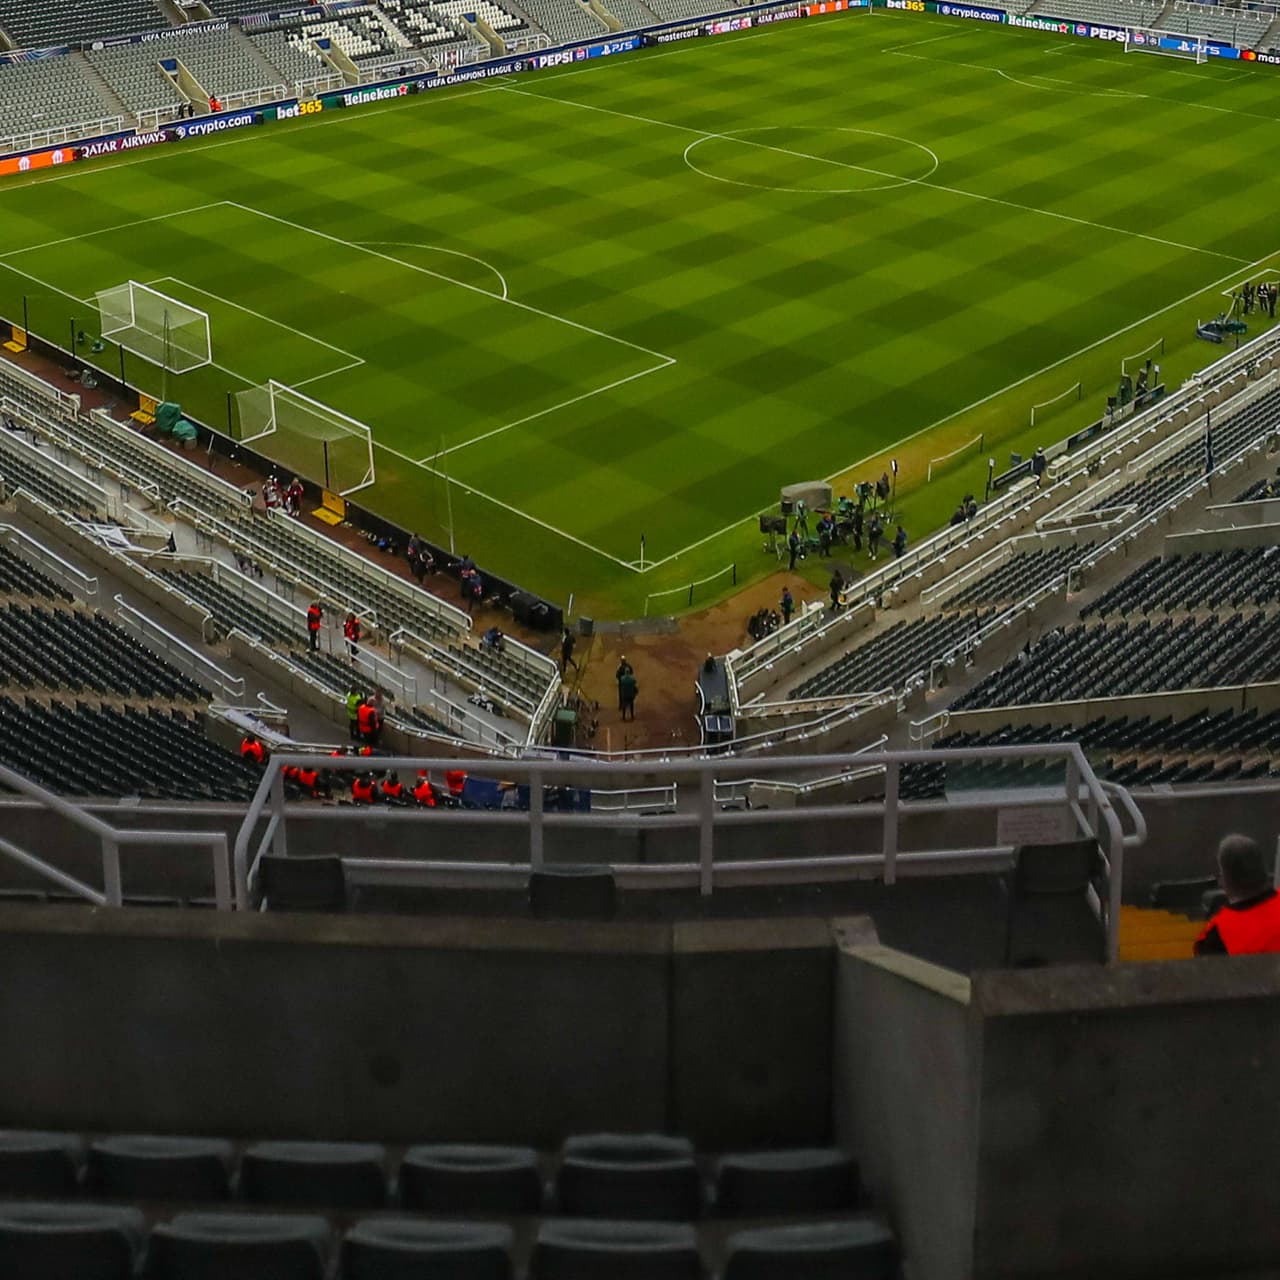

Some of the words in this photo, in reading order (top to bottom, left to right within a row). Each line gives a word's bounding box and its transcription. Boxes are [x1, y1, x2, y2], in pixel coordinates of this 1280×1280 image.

[951, 6, 1000, 22] crypto.com
[1007, 15, 1059, 33] Heineken
[141, 32, 160, 42] UEFA
[160, 26, 202, 39] CHAMPIONS
[657, 28, 700, 44] mastercard
[1090, 26, 1130, 43] PEPSI
[611, 40, 634, 54] PS5
[539, 51, 574, 69] PEPSI
[427, 76, 446, 88] UEFA
[446, 69, 486, 85] CHAMPIONS
[487, 63, 513, 77] LEAGUE
[343, 88, 398, 107] Heineken
[276, 99, 323, 121] bet365
[188, 114, 252, 137] crypto.com
[80, 140, 117, 159] QATAR
[120, 130, 167, 150] AIRWAYS
